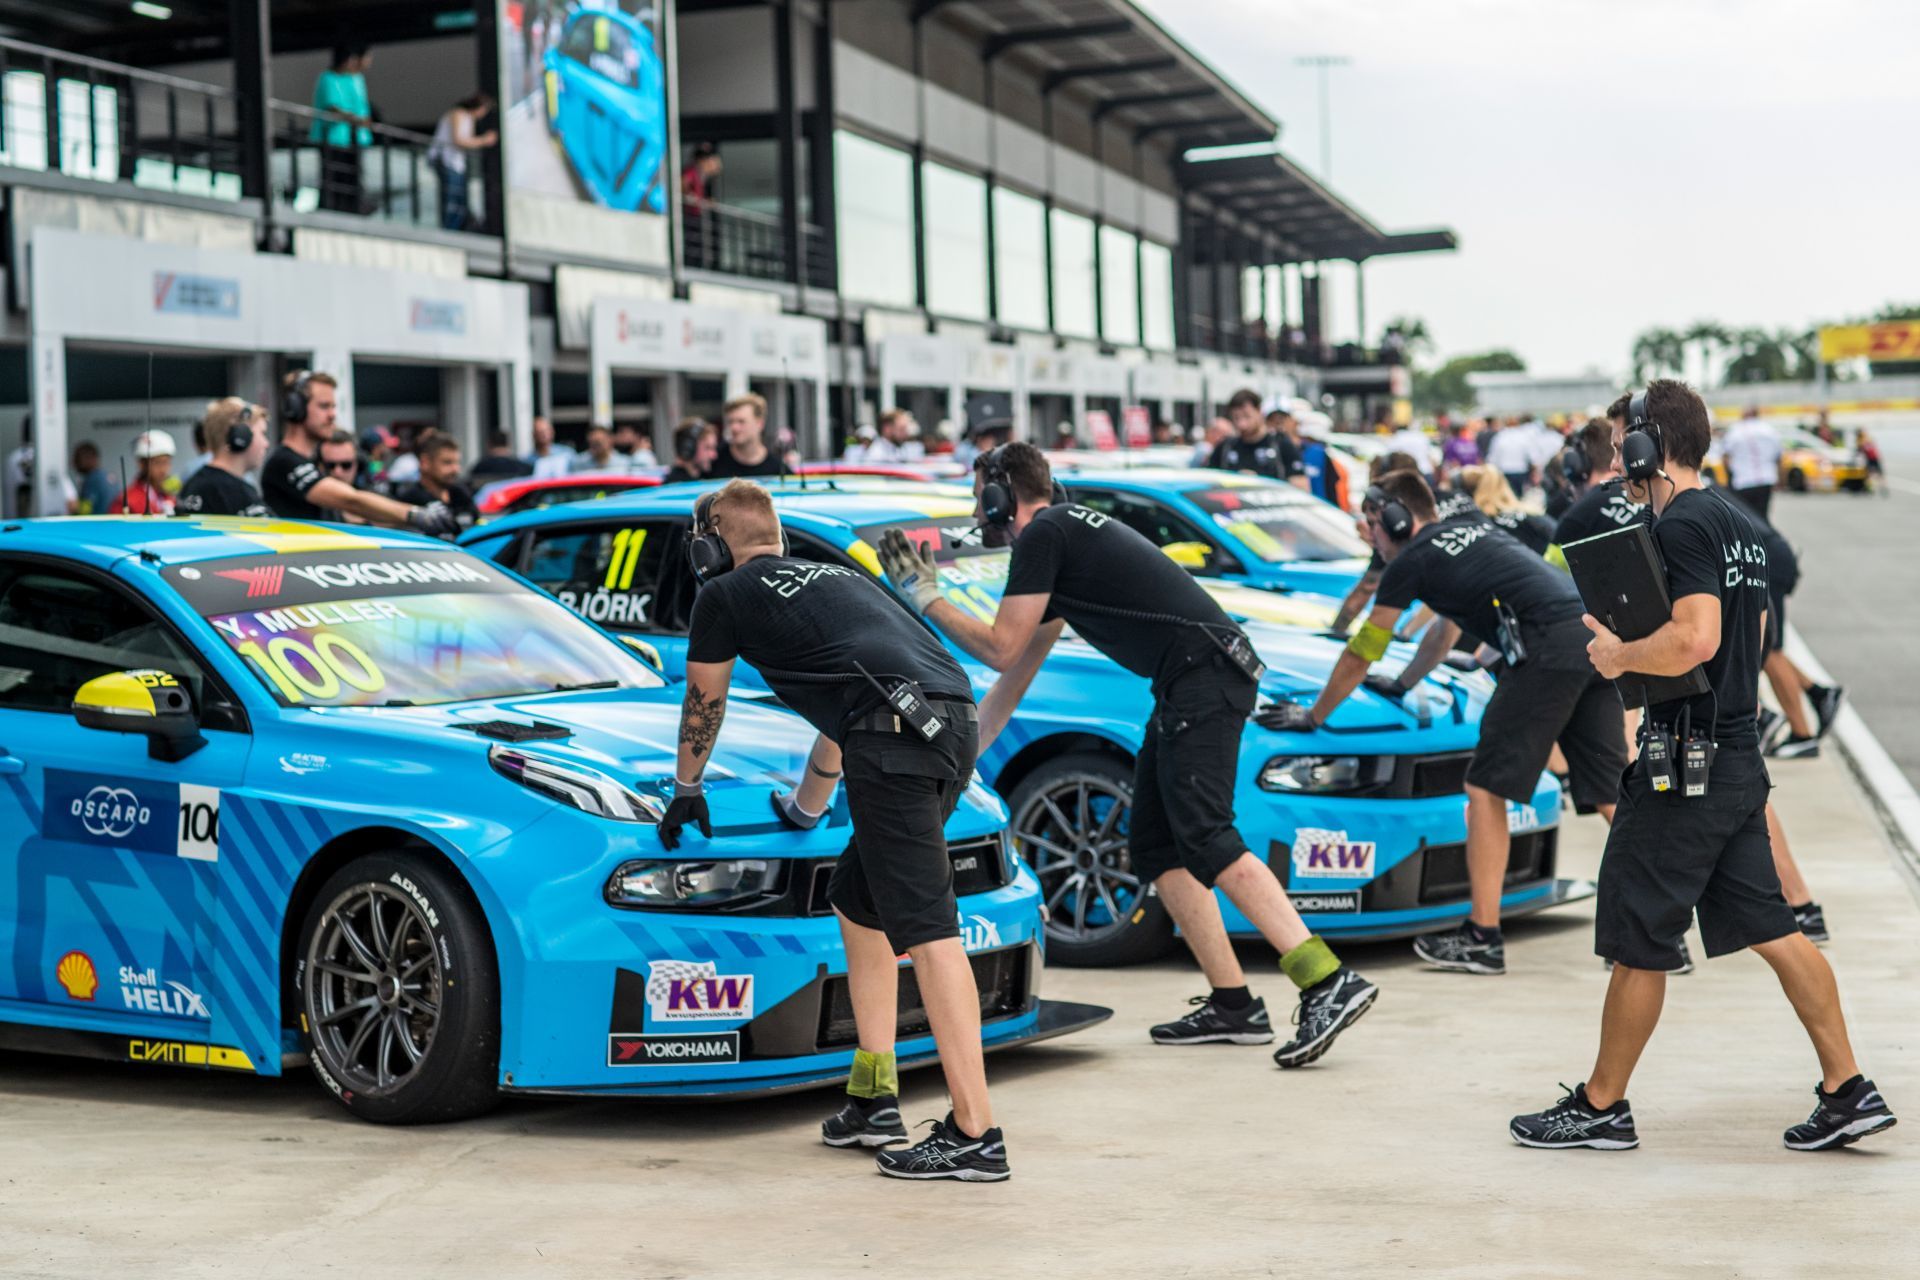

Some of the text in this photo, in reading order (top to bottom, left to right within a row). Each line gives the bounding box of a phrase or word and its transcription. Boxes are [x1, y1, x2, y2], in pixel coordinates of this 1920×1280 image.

[288, 559, 491, 589] YOKOHAMA
[604, 528, 648, 590] 11
[253, 600, 408, 634] MULLER
[558, 586, 652, 623] BJÖRK
[237, 632, 386, 703] 100
[71, 798, 150, 825] OSCARO
[1307, 843, 1372, 870] KW
[390, 872, 439, 928] ADVAN
[119, 965, 156, 986] Shell
[121, 984, 211, 1018] HELIX
[667, 977, 752, 1011] KW
[643, 1040, 733, 1058] YOKOHAMA
